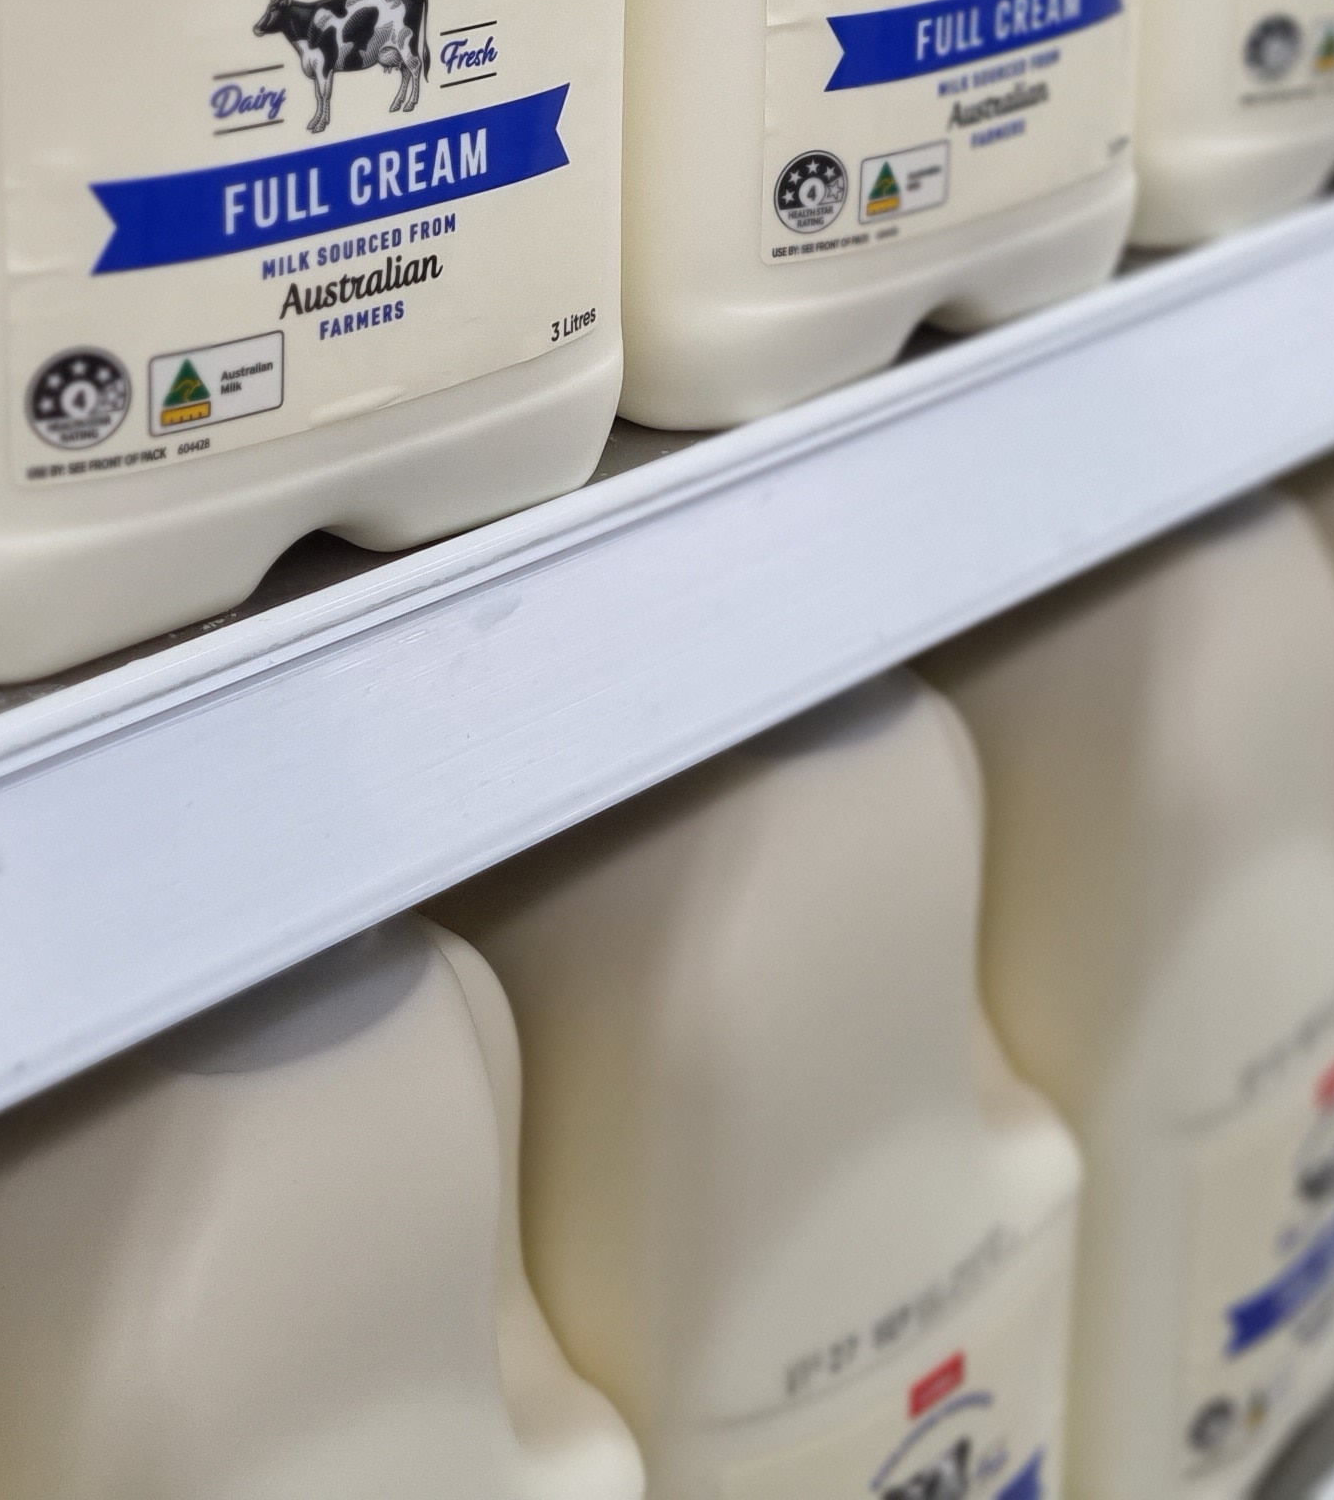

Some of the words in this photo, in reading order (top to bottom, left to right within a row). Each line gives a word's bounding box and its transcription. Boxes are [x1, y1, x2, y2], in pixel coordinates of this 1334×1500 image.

[916, 7, 983, 61] FULL
[440, 35, 498, 74] Fresh
[210, 84, 286, 120] Dairy
[224, 167, 330, 236] FULL
[349, 127, 488, 207] CREAM
[806, 184, 817, 201] 4
[788, 208, 815, 220] HEALTH
[816, 206, 834, 217] STAR
[797, 216, 824, 229] RATING
[262, 250, 310, 280] MILK
[317, 227, 403, 267] SOURCED
[409, 212, 456, 244] FROM
[772, 246, 787, 258] USE
[788, 244, 800, 256] BY:
[279, 253, 443, 320] Australian
[319, 300, 405, 341] FARMERS
[550, 322, 560, 342] 3
[562, 306, 597, 338] Litres
[220, 361, 273, 382] Australian
[220, 381, 242, 396] Milk
[89, 453, 122, 473] FRONT
[141, 446, 167, 463] PACK
